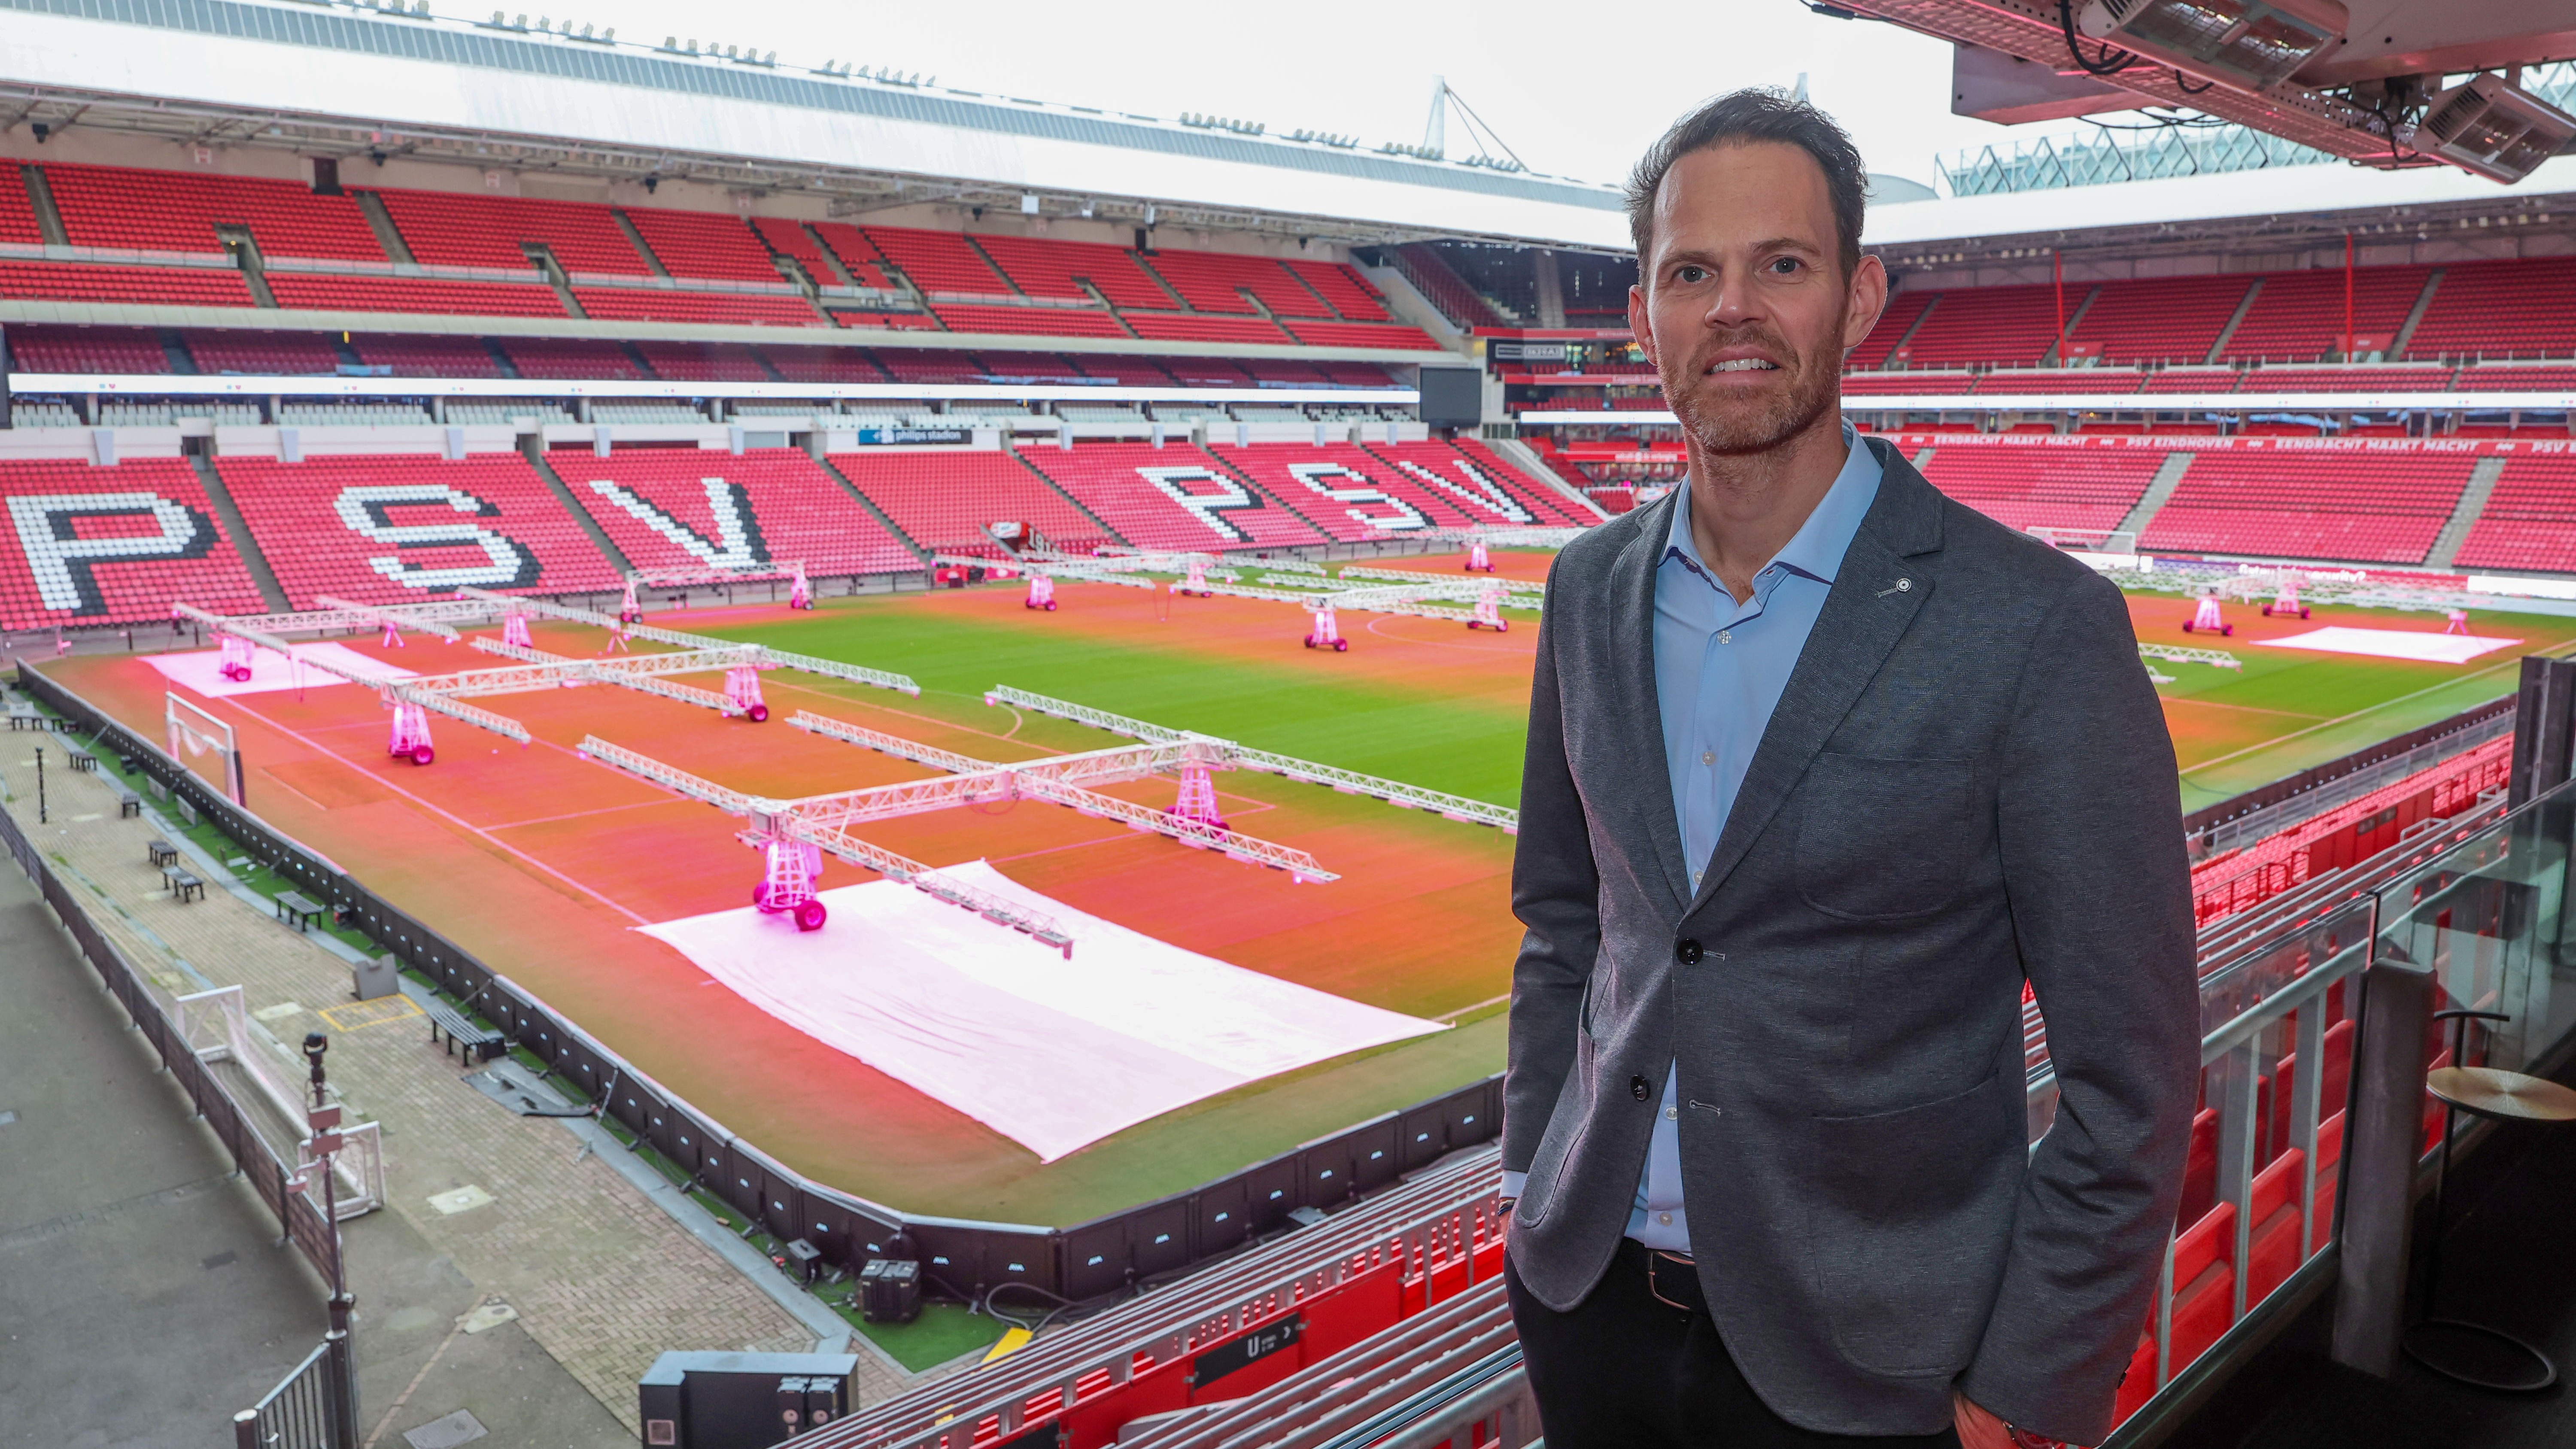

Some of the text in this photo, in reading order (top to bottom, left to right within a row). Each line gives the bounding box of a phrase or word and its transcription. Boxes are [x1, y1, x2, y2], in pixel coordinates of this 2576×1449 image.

[927, 429, 961, 440] stadion
[1934, 434, 2089, 446] EENDRACHT MAAKT MACHT
[2126, 437, 2234, 448] PSV EINDHOVEN
[2275, 437, 2479, 452] EENDRACHT MAAKT MACHT
[2531, 441, 2566, 453] PSV
[1248, 1336, 1260, 1358] U
